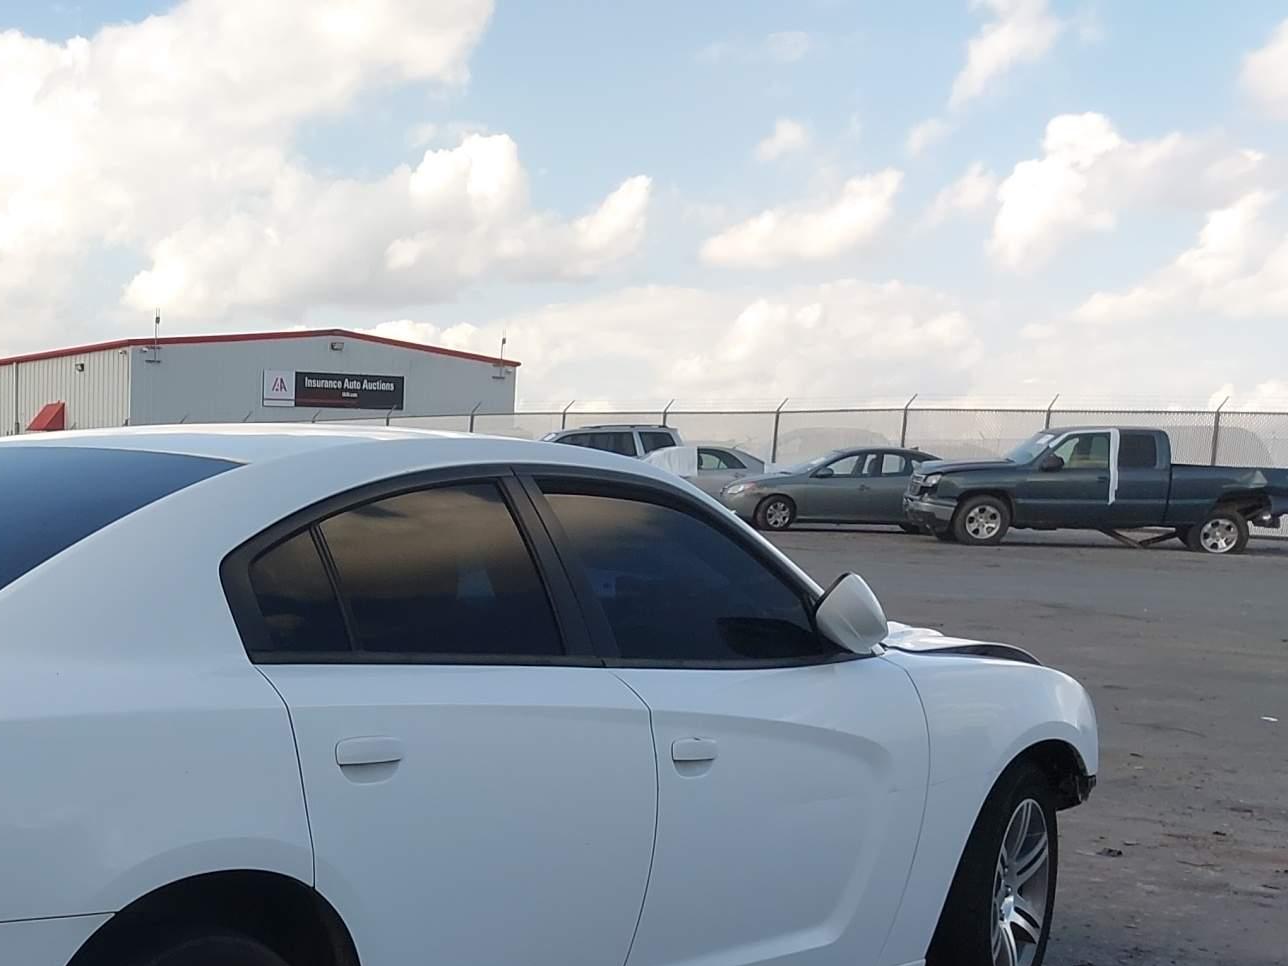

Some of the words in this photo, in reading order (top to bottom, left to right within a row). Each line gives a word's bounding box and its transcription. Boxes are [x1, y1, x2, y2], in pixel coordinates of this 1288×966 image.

[304, 376, 342, 389] Insurance
[343, 377, 361, 390] Auto
[362, 379, 395, 391] Auctions
